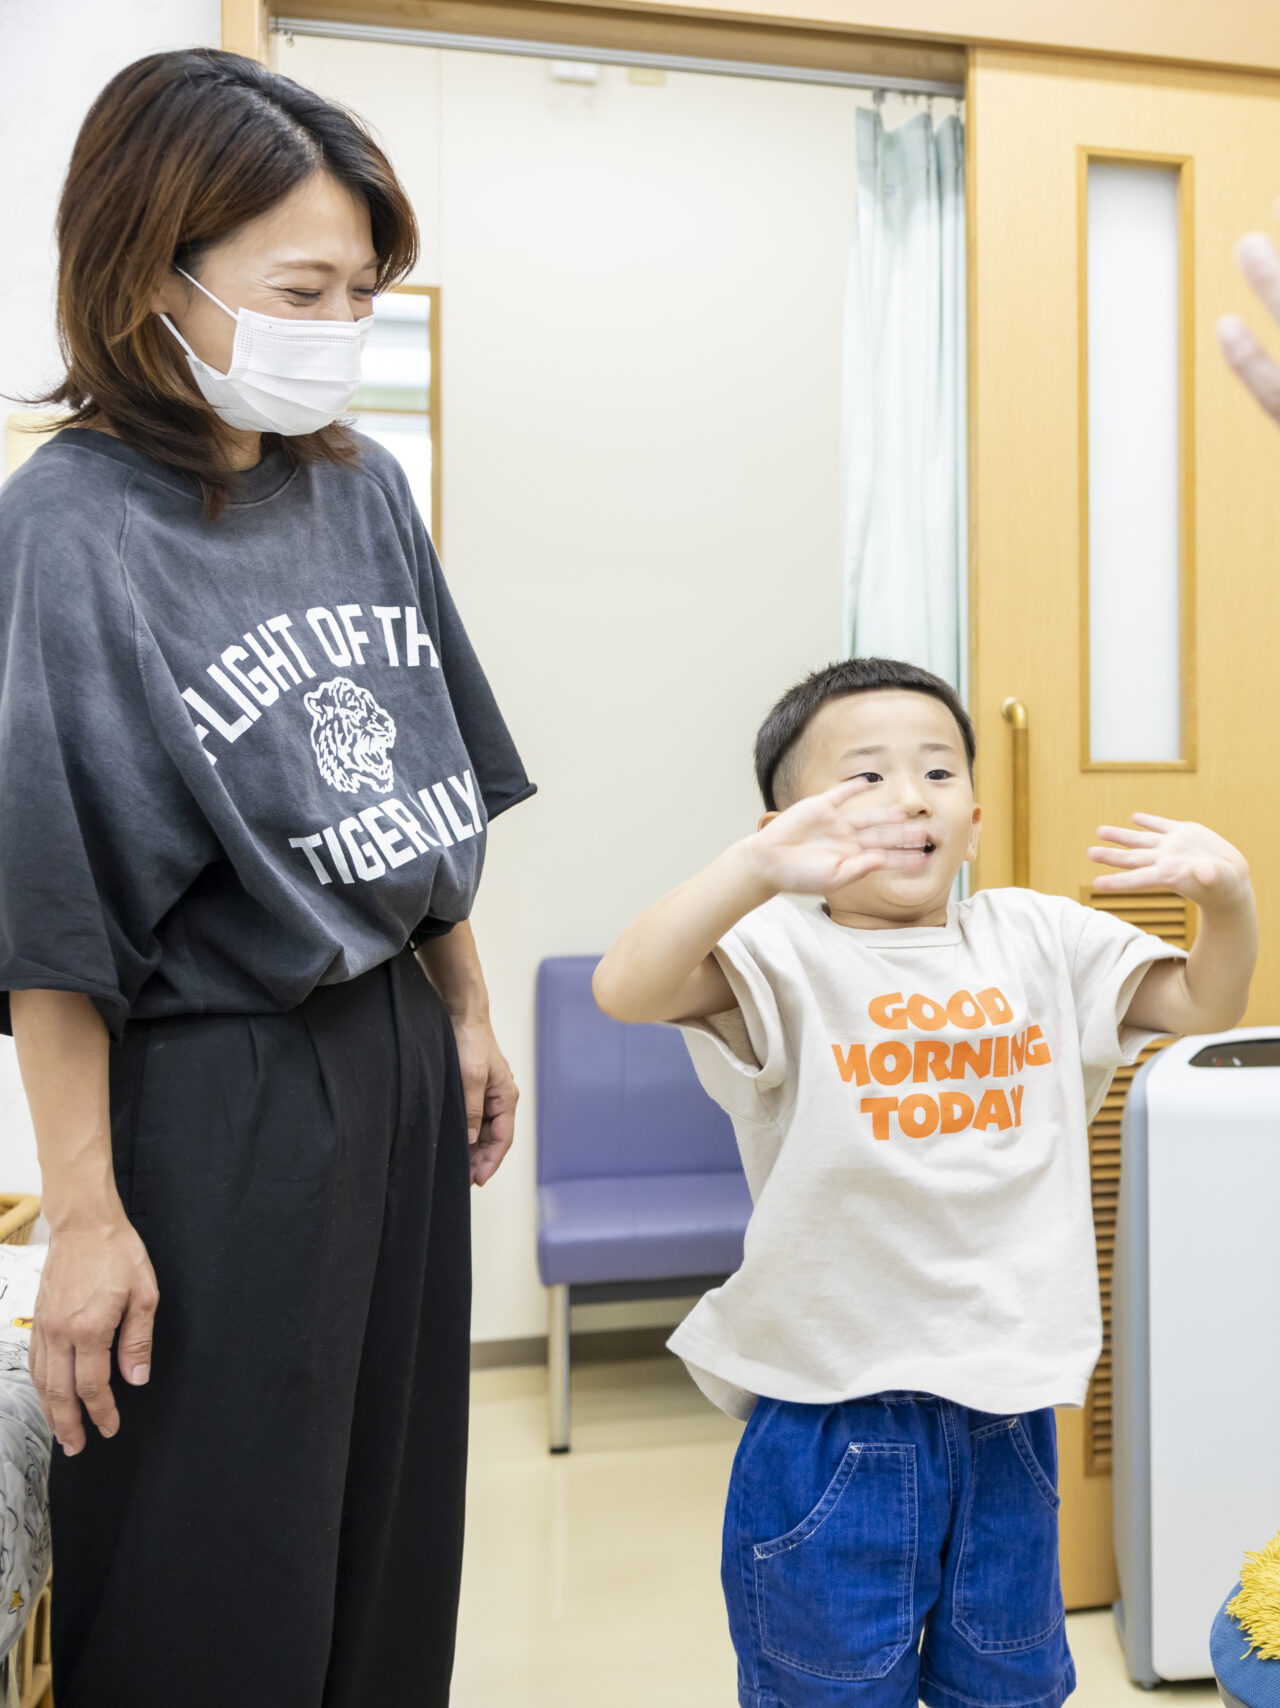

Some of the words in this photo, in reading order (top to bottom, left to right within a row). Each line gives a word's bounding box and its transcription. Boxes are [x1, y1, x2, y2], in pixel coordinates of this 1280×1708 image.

[305, 603, 370, 668] OF
[371, 604, 440, 669] TH
[407, 768, 484, 848] ILY
[867, 986, 1014, 1032] GOOD
[831, 1024, 1052, 1087] MORNING
[860, 1084, 1024, 1141] TODAY
